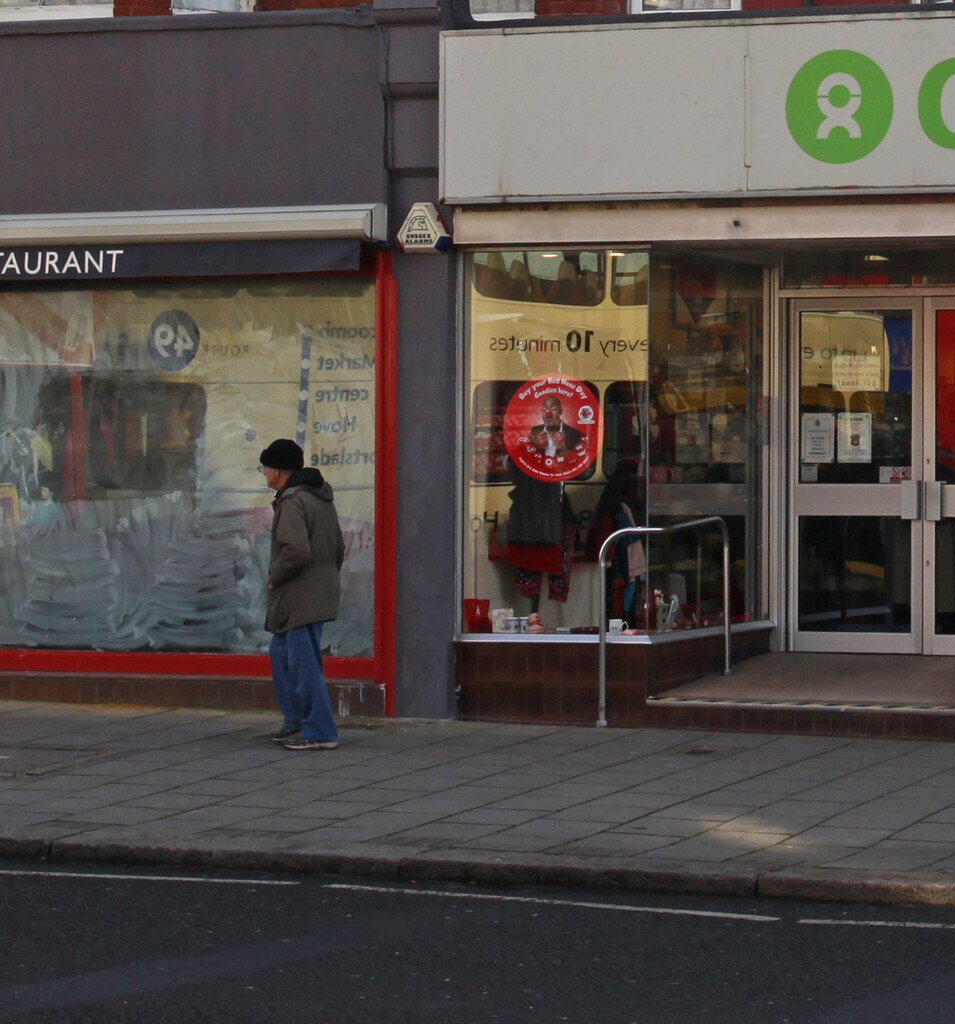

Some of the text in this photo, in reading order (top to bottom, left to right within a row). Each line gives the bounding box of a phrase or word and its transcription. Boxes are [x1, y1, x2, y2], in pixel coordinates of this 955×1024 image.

[0, 250, 124, 274] AURANT
[518, 387, 531, 400] Buy
[532, 379, 546, 391] your
[561, 378, 576, 390] Nose
[575, 385, 588, 400] Day
